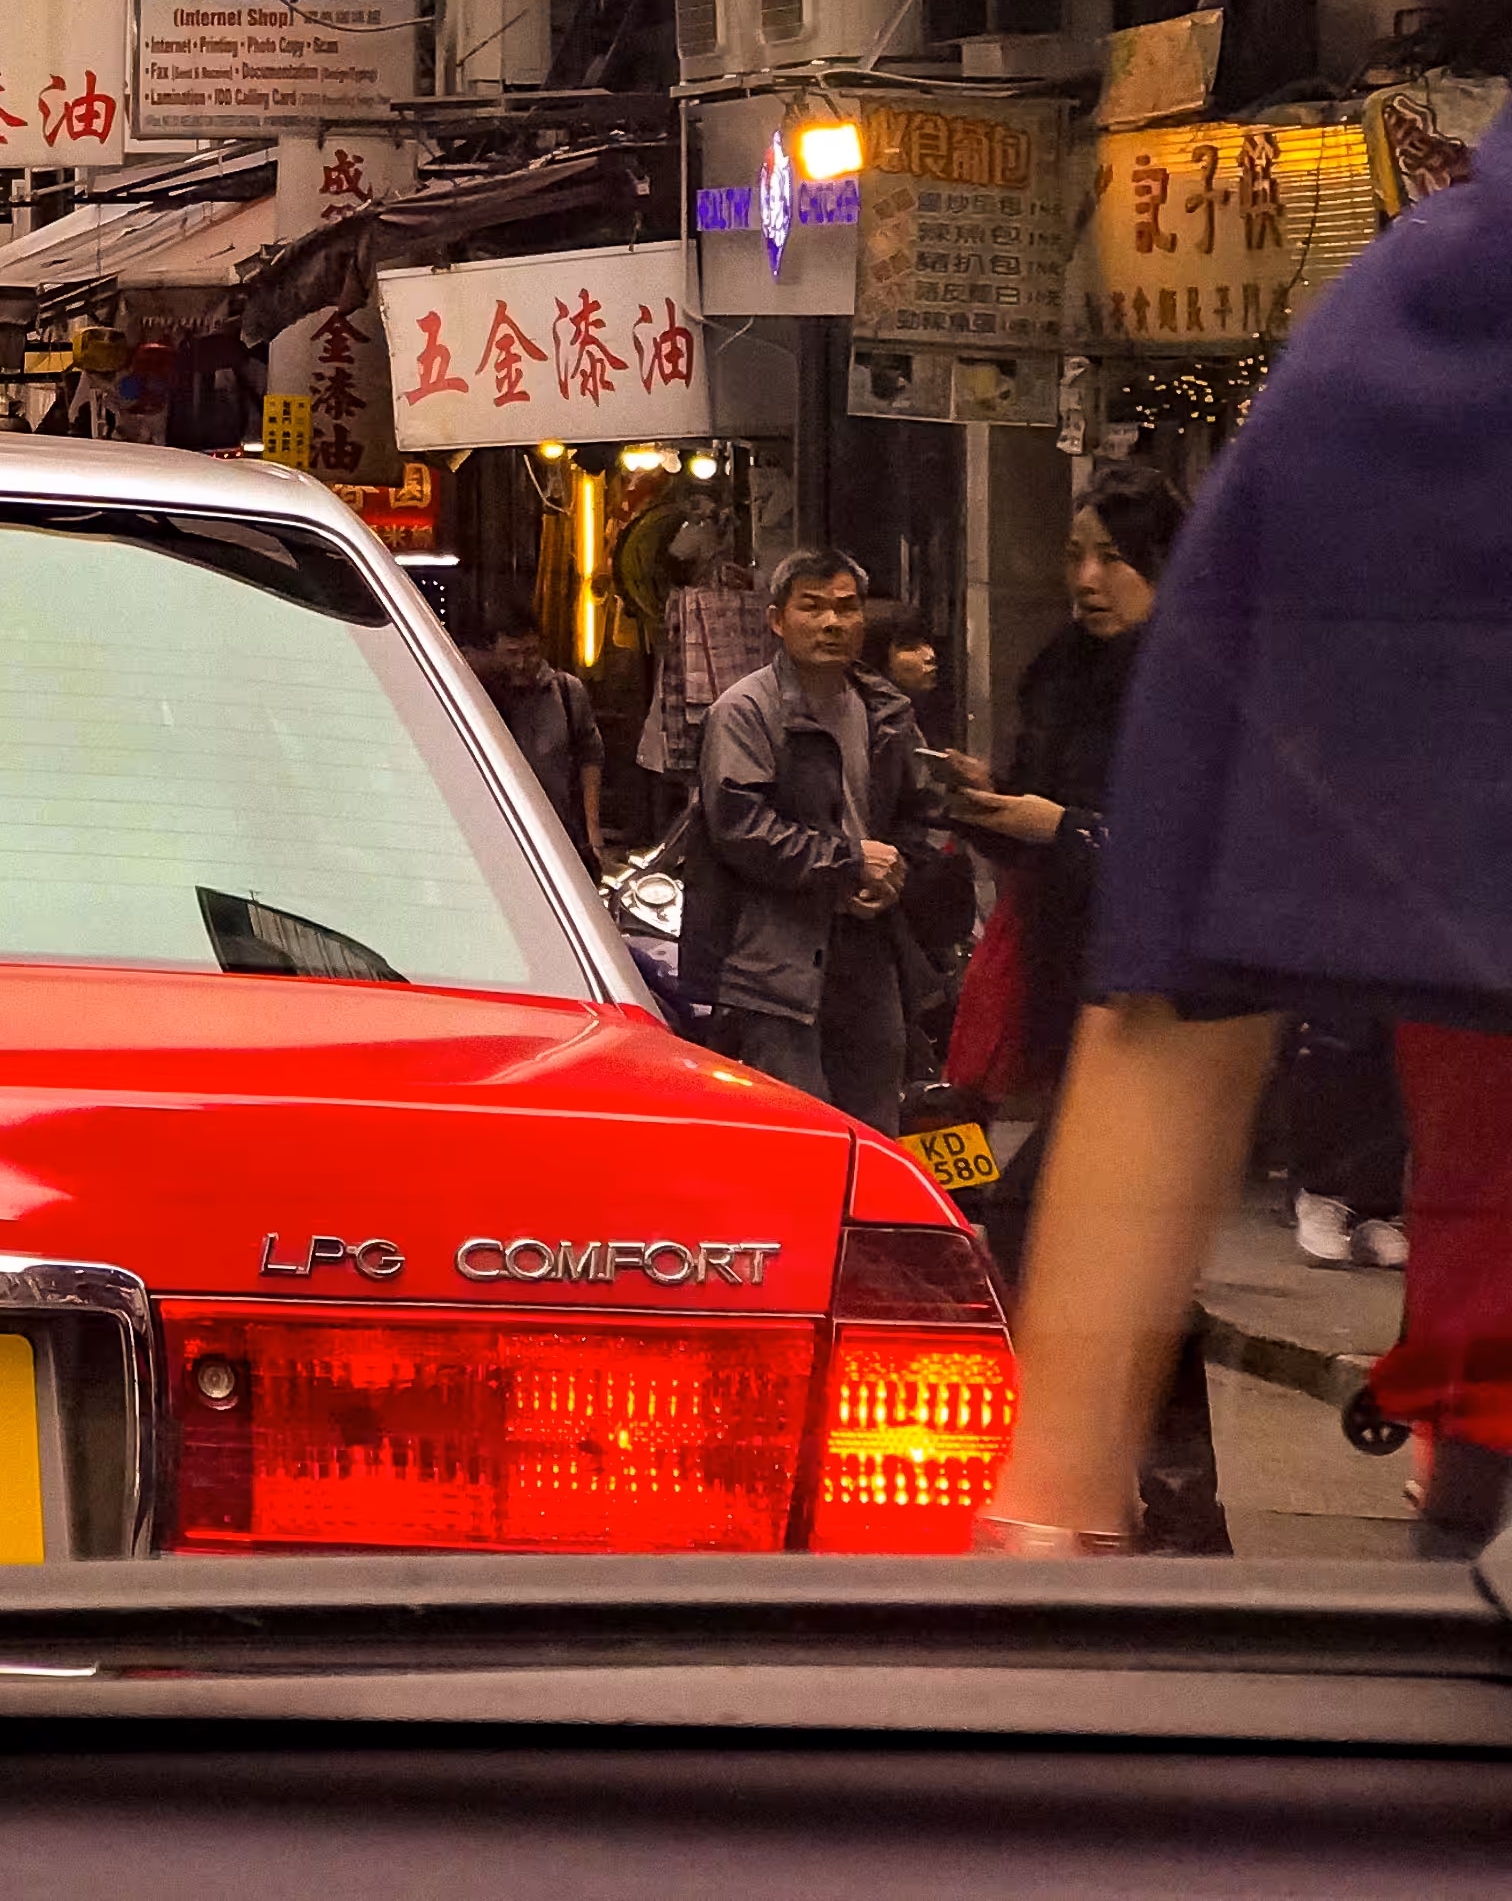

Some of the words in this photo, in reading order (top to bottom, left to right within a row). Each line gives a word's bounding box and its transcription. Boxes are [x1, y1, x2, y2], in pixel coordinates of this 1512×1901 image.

[405, 288, 694, 408] 五金漆油
[919, 1132, 966, 1162] KD
[934, 1154, 993, 1186] 580
[454, 1237, 782, 1286] COMFORT
